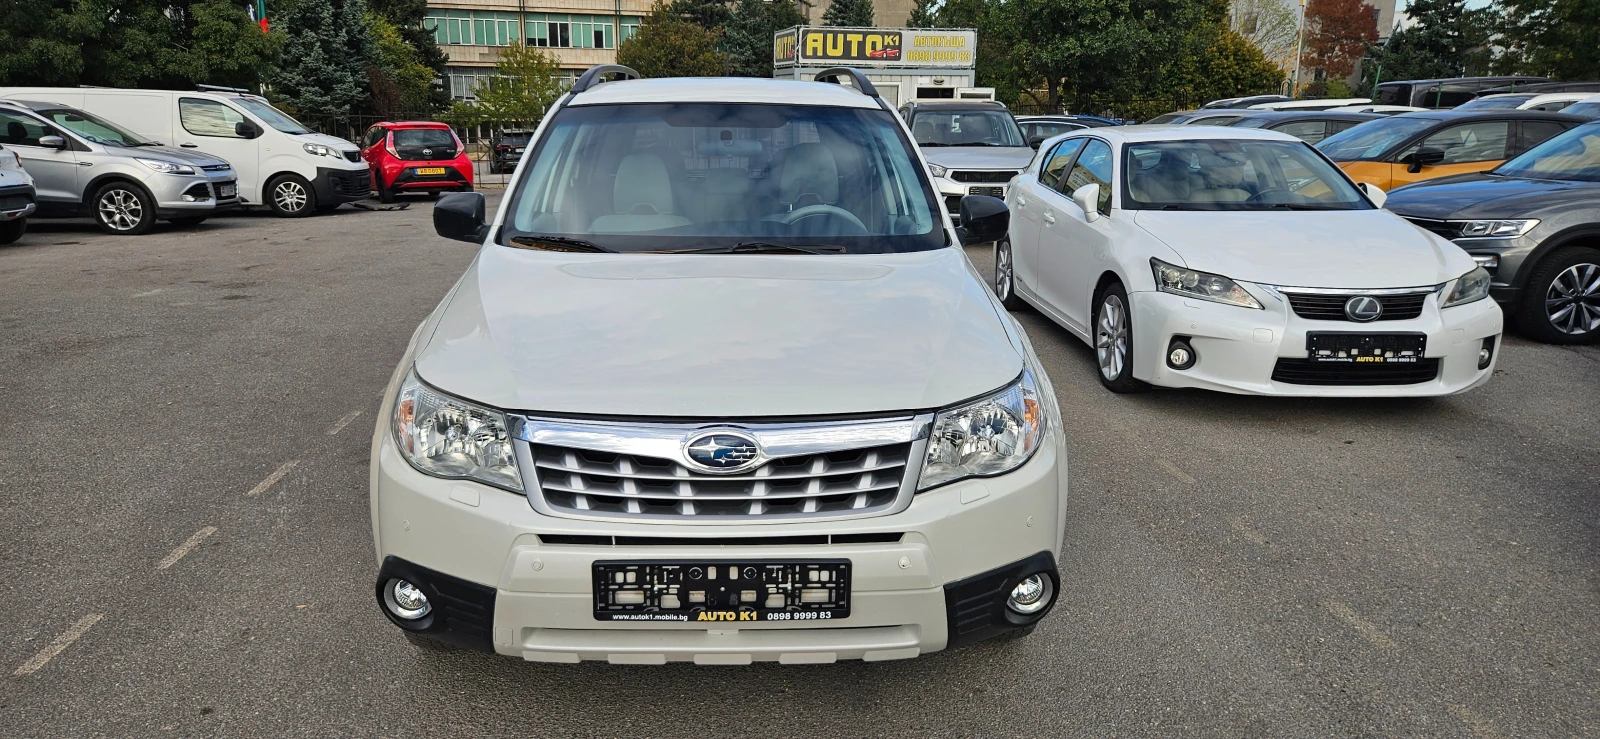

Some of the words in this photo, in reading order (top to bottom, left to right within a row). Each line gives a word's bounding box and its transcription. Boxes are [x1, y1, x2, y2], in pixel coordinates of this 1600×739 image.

[806, 33, 882, 57] AUTO
[884, 35, 899, 46] K1
[914, 36, 965, 48] АВТОКЪЩА
[907, 50, 931, 62] 0898
[933, 50, 957, 62] 9999
[698, 612, 736, 620] AUTO
[740, 612, 757, 620] K1
